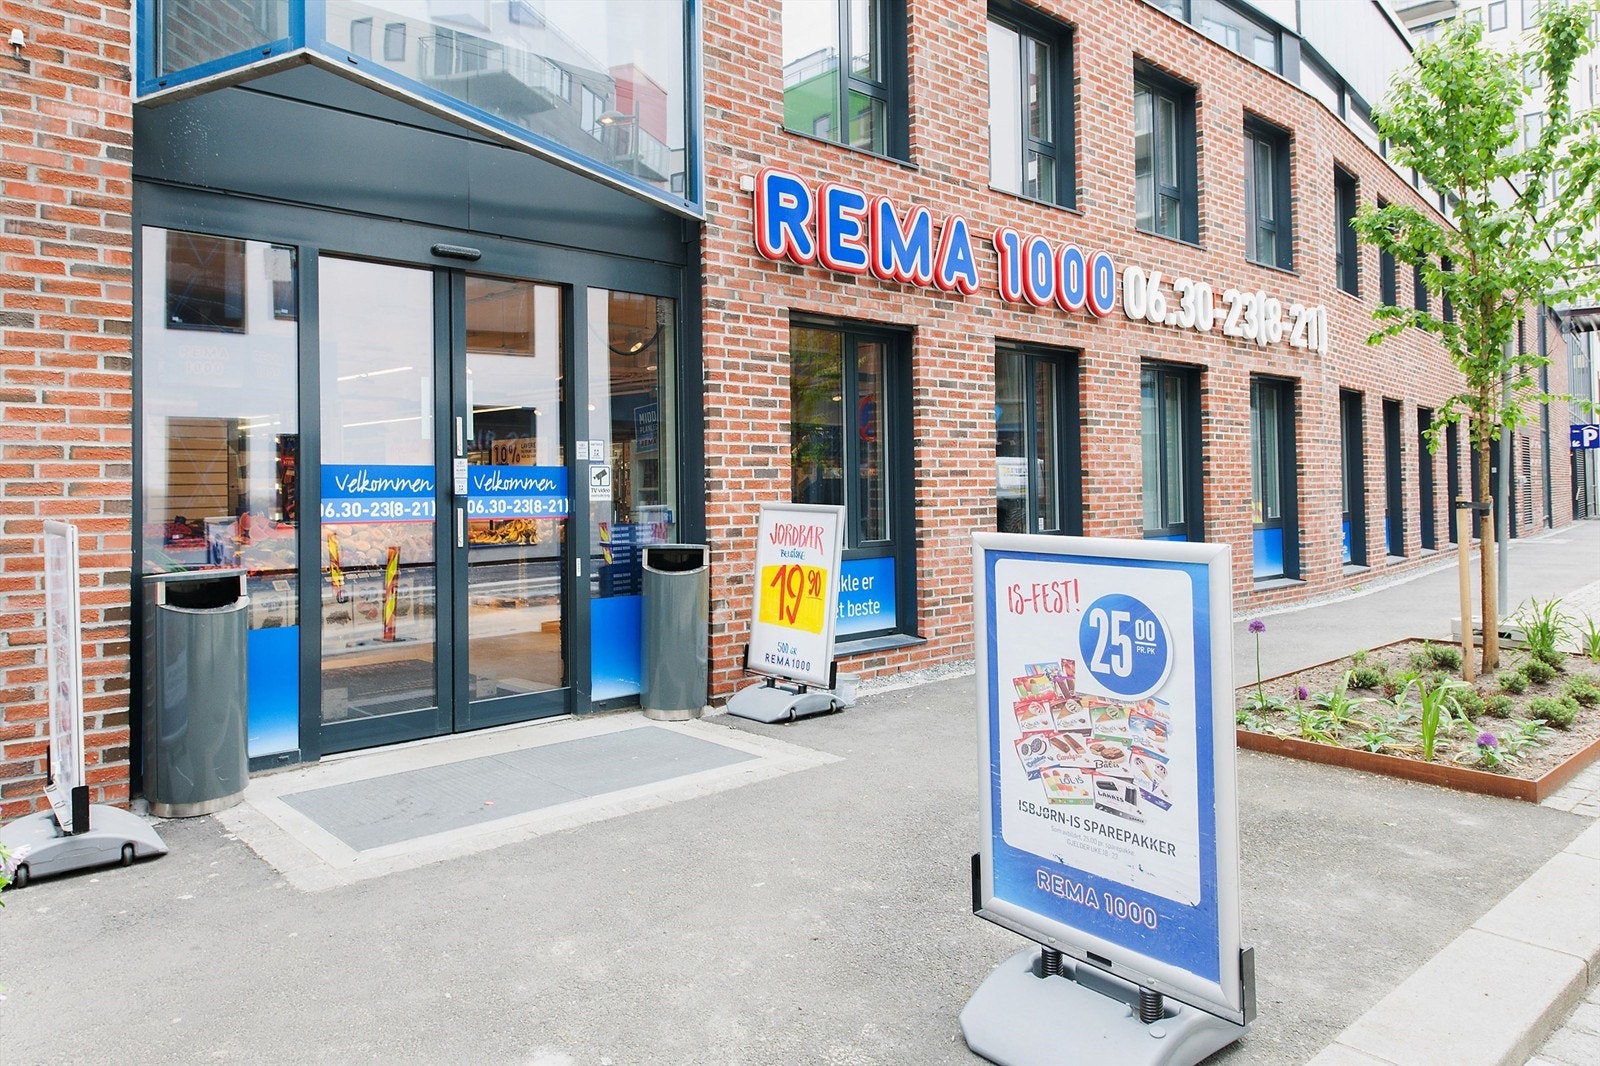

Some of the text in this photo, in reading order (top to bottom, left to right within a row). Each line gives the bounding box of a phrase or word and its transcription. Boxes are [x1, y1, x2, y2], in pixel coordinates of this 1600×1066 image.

[755, 165, 1117, 318] REMA 1000
[1583, 429, 1598, 447] P
[494, 445, 520, 463] 10%
[335, 469, 434, 494] Velkommen
[474, 470, 557, 491] Velkommen
[770, 564, 805, 625] 19
[838, 574, 875, 592] kle er
[847, 598, 881, 618] beste
[1007, 578, 1081, 615] IS-FEST!
[777, 642, 789, 654] 500
[1089, 607, 1156, 677] 25 00
[765, 653, 811, 672] REMA 1000
[1018, 799, 1177, 857] ISBJØRN-IS SPAREPAKKER
[1036, 869, 1158, 929] REMA 1000
